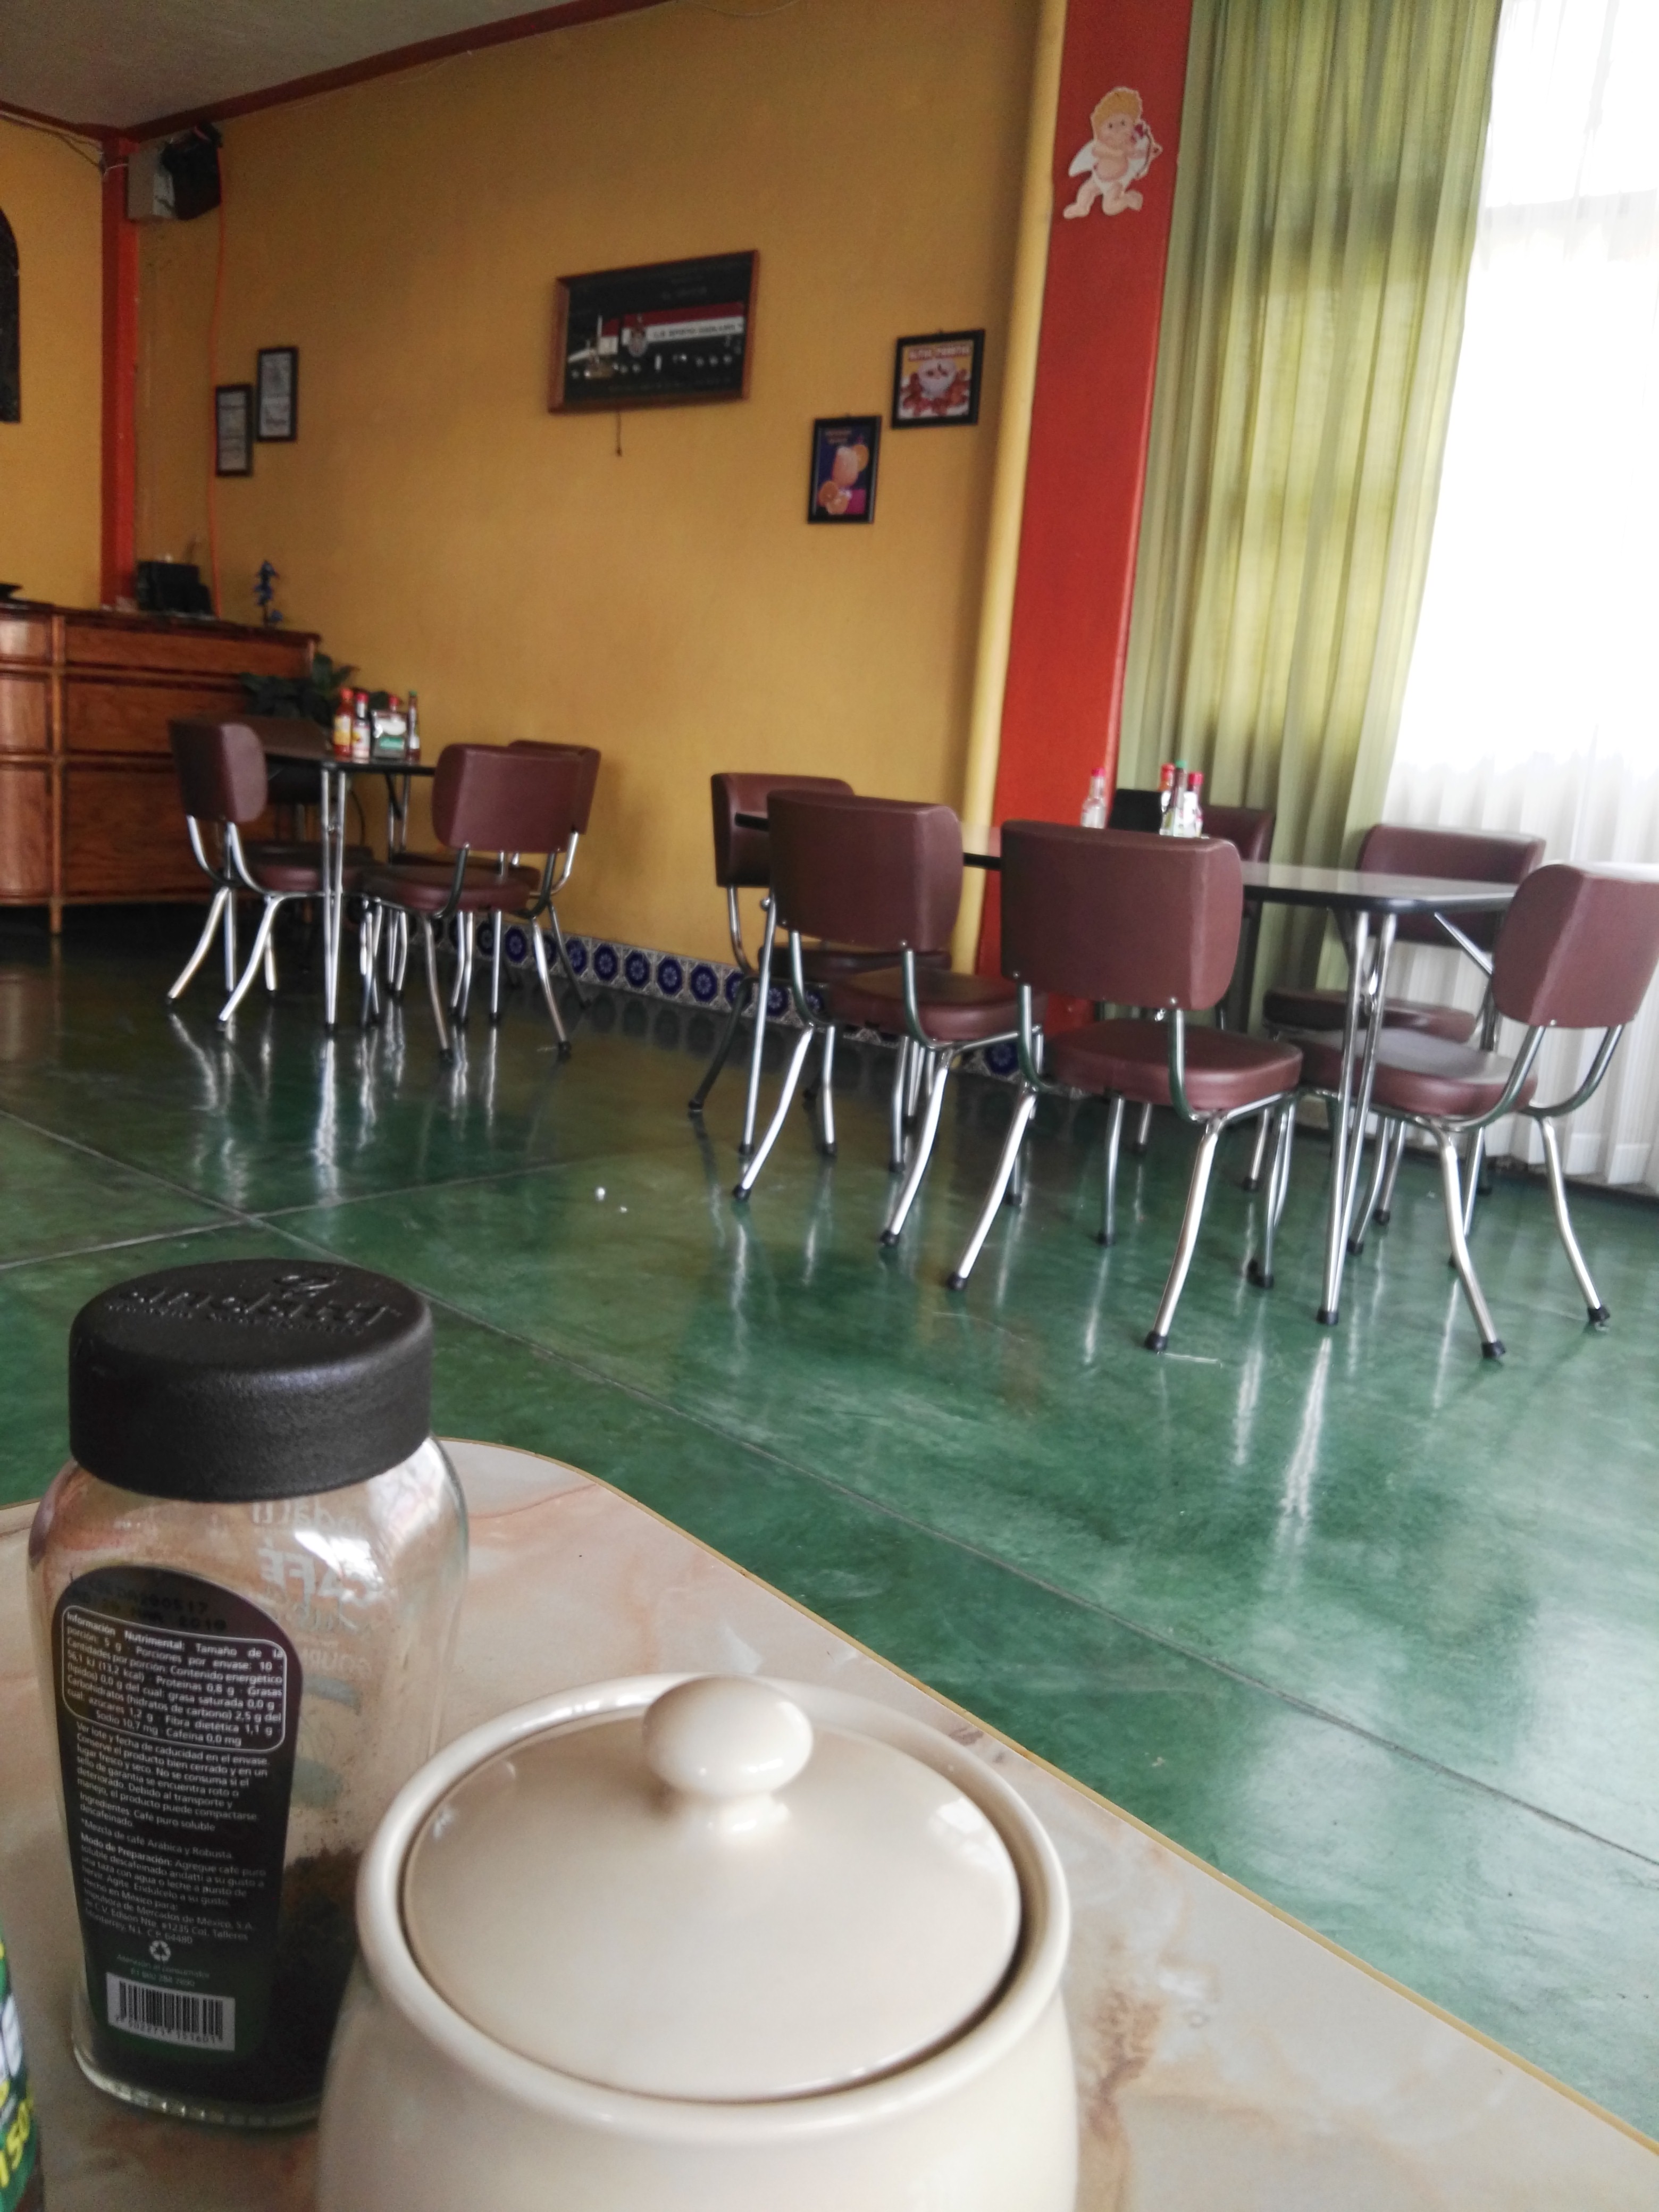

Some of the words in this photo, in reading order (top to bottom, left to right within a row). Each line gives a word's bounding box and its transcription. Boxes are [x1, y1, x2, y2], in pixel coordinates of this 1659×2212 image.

[68, 1612, 115, 1636] Información
[195, 1643, 237, 1657] Tamaño
[247, 1648, 262, 1658] de
[272, 1649, 283, 1659] la
[104, 1637, 110, 1647] 5
[115, 1643, 122, 1653] g
[136, 1646, 182, 1664] Porciones
[188, 1657, 206, 1666] por
[213, 1660, 252, 1671] envase:
[259, 1662, 272, 1672] 10
[68, 1637, 111, 1660] Cantidades
[113, 1655, 127, 1665] por
[170, 1666, 223, 1680] Contenido
[225, 1674, 282, 1686] energético
[68, 1675, 124, 1701] Carbohidratos
[127, 1694, 168, 1712] (hidratos
[171, 1705, 183, 1714] de
[187, 1707, 232, 1720] carbono)
[235, 1711, 251, 1722] 2,5
[254, 1714, 262, 1724] g
[264, 1713, 281, 1723] del
[116, 1681, 122, 1690] g
[125, 1683, 139, 1692] del
[167, 1692, 195, 1703] grasa
[198, 1697, 244, 1708] saturada
[266, 1703, 274, 1712] g
[123, 1669, 145, 1683] kcal)
[227, 1687, 234, 1697] g
[247, 1686, 282, 1698] Grasas
[88, 1697, 124, 1714] azúcares
[146, 1713, 153, 1723] g
[165, 1715, 189, 1728] Fibra
[195, 1721, 239, 1733] dietética
[265, 1727, 272, 1737] g
[96, 1710, 120, 1725] Sodio
[143, 1725, 158, 1736] mg
[224, 1737, 241, 1747] mg
[77, 1722, 89, 1732] Ver
[91, 1727, 106, 1739] lote
[116, 1735, 139, 1748] fecha
[141, 1743, 153, 1752] de
[155, 1746, 204, 1761] caducidad
[206, 1754, 218, 1762] en
[221, 1755, 230, 1763] el
[77, 1733, 112, 1752] Conserve
[124, 1750, 164, 1765] producto
[167, 1758, 187, 1769] bien
[190, 1764, 228, 1774] cerrado
[77, 1744, 96, 1757] lugar
[99, 1752, 123, 1767] fresco
[125, 1762, 130, 1771] y
[156, 1767, 169, 1778] No
[184, 1774, 227, 1786] consuma
[240, 1779, 249, 1788] el
[77, 1756, 94, 1767] sello
[96, 1763, 106, 1772] de
[157, 1780, 206, 1794] encuentra
[208, 1788, 229, 1797] roto
[111, 1790, 118, 1798] el
[120, 1794, 160, 1809] producto
[162, 1802, 192, 1815] puede
[129, 1782, 161, 1798] Debido
[174, 1792, 225, 1807] transporte
[114, 1831, 124, 1840] de
[156, 1816, 179, 1828] puro
[181, 1821, 215, 1832] soluble
[81, 1832, 104, 1848] Modo
[105, 1842, 116, 1853] de
[118, 1846, 172, 1866] Preparación:
[175, 1859, 216, 1873] Agregue
[242, 1869, 266, 1877] puro
[81, 1845, 107, 1861] soluble
[110, 1855, 167, 1875] descafeinado
[227, 1878, 255, 1888] gusto
[97, 1861, 114, 1873] taza
[117, 1869, 132, 1878] con
[135, 1874, 156, 1885] agua
[167, 1880, 191, 1891] leche
[203, 1886, 231, 1896] punto
[124, 1903, 134, 1911] de
[137, 1906, 180, 1921] Mercados
